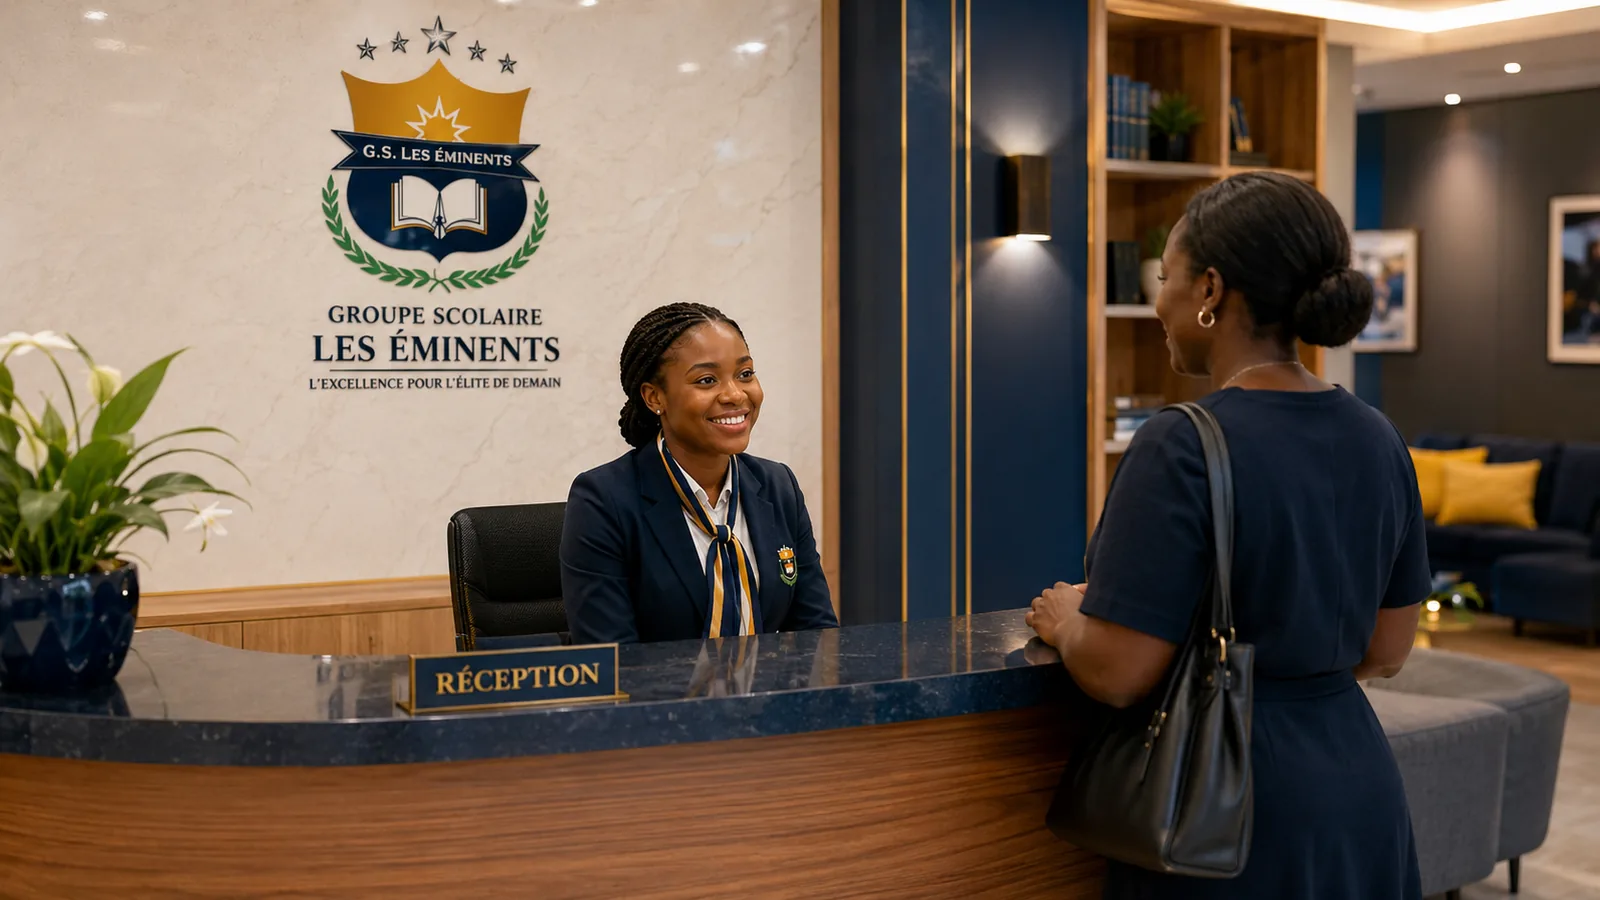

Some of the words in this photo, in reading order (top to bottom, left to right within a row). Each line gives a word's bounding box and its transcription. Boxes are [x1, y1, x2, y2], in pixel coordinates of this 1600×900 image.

[362, 144, 396, 159] G.S.
[401, 147, 430, 162] LES
[434, 147, 512, 166] ÉMINENTS
[328, 305, 425, 324] GROUPE
[433, 307, 543, 326] SCOLAIRE
[313, 334, 375, 362] LES
[389, 328, 560, 362] ÉMINENTS
[309, 377, 404, 390] L'EXCELLENCE
[407, 377, 442, 389] POUR
[446, 375, 490, 389] L'ÉLITE
[493, 377, 510, 388] DE
[512, 377, 562, 388] DEMAIN
[435, 662, 600, 695] RÉCEPTION
